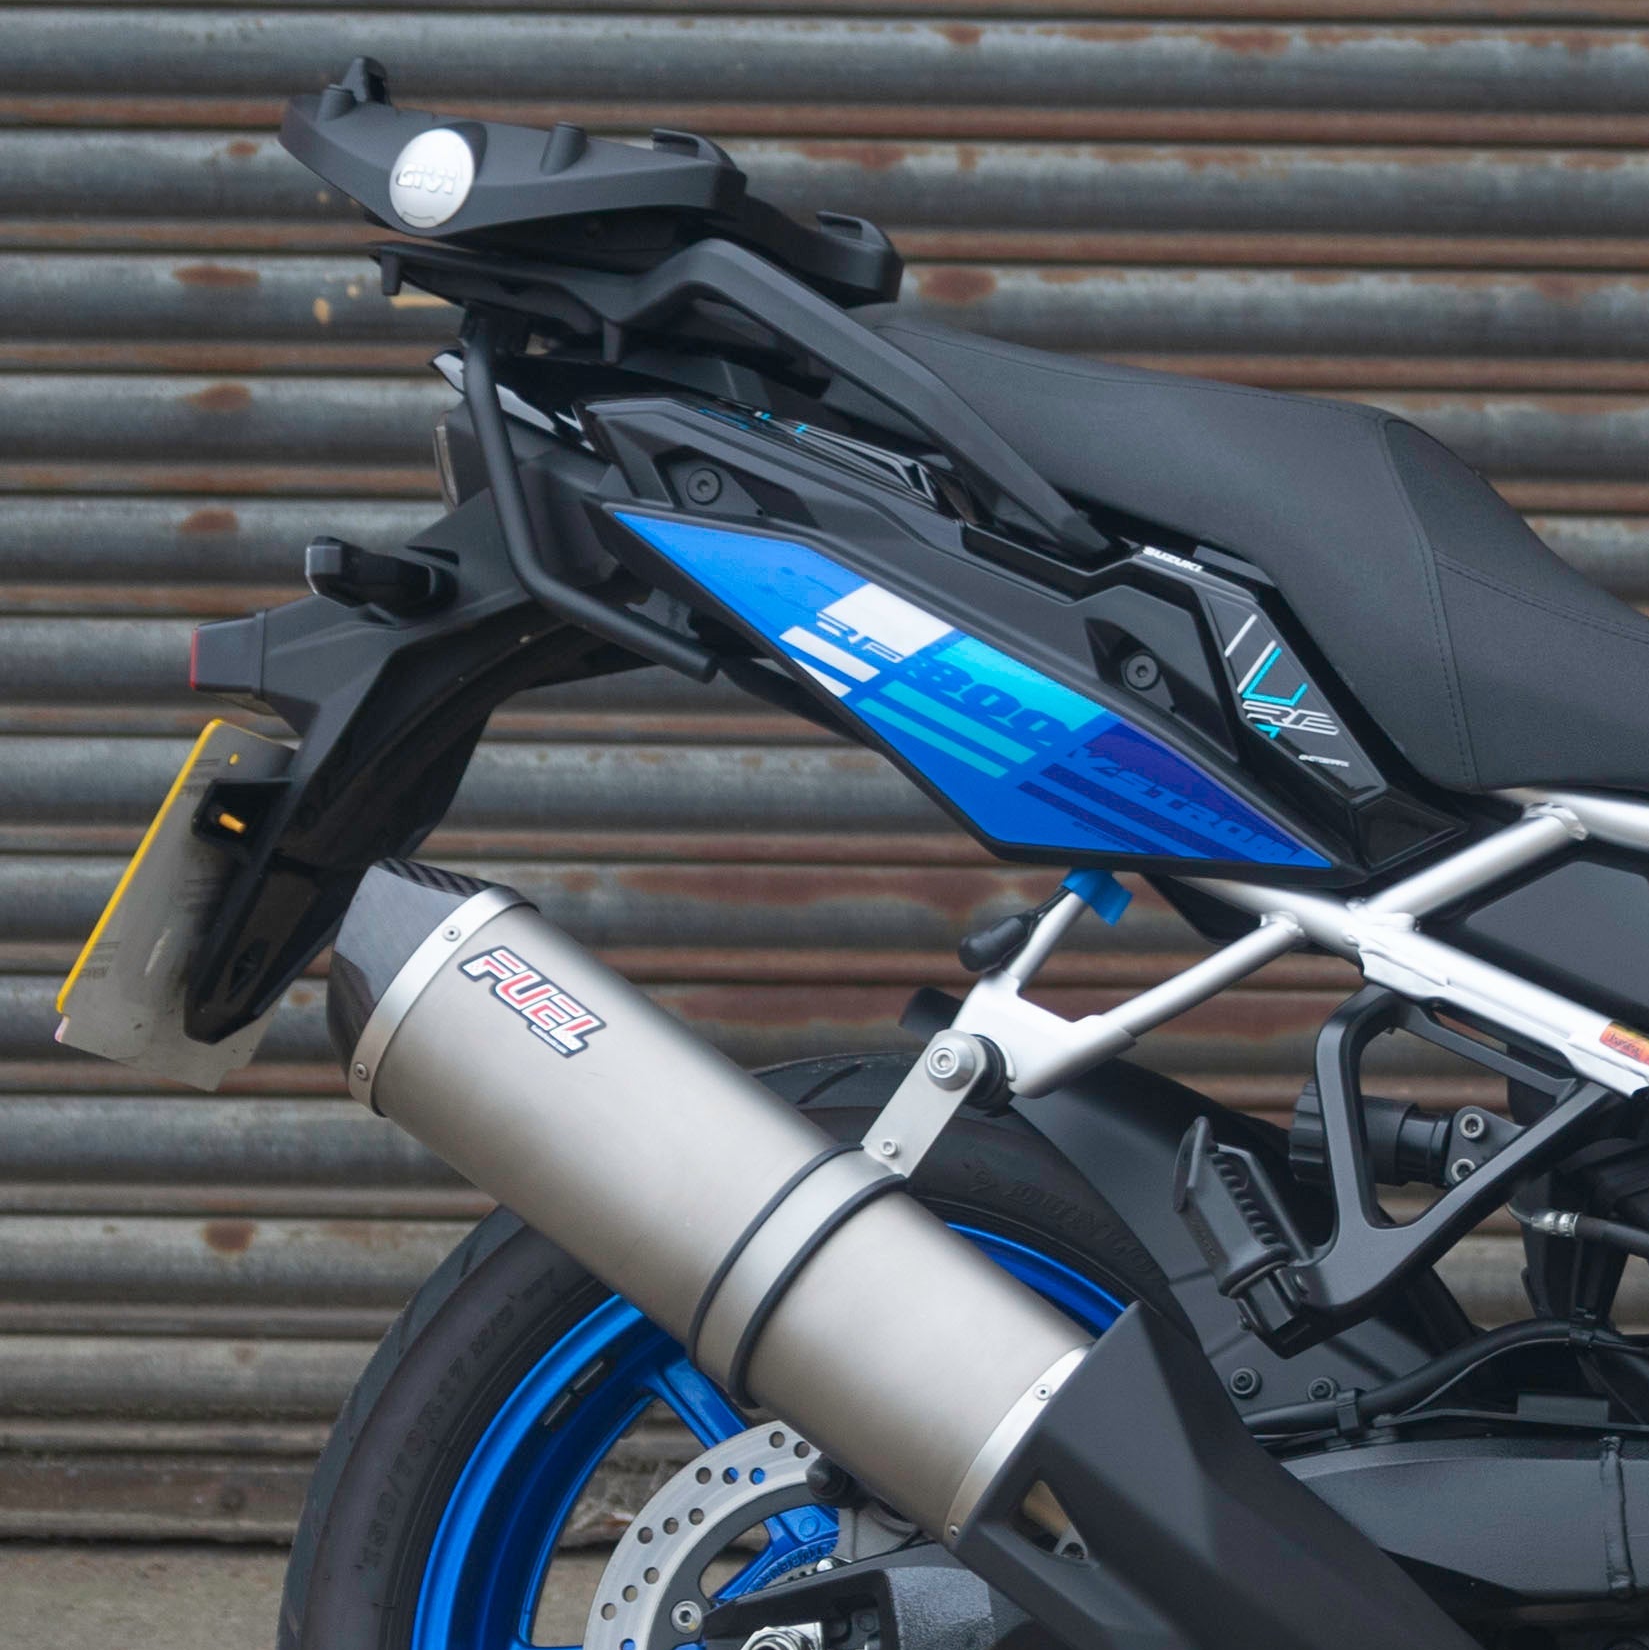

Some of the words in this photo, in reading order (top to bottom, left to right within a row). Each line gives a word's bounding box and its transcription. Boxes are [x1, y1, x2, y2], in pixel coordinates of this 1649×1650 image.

[395, 162, 457, 195] GIVI
[1142, 545, 1204, 573] SUZUKI
[905, 654, 1074, 748] 800
[1243, 701, 1340, 736] RE
[461, 948, 602, 1052] FUEL
